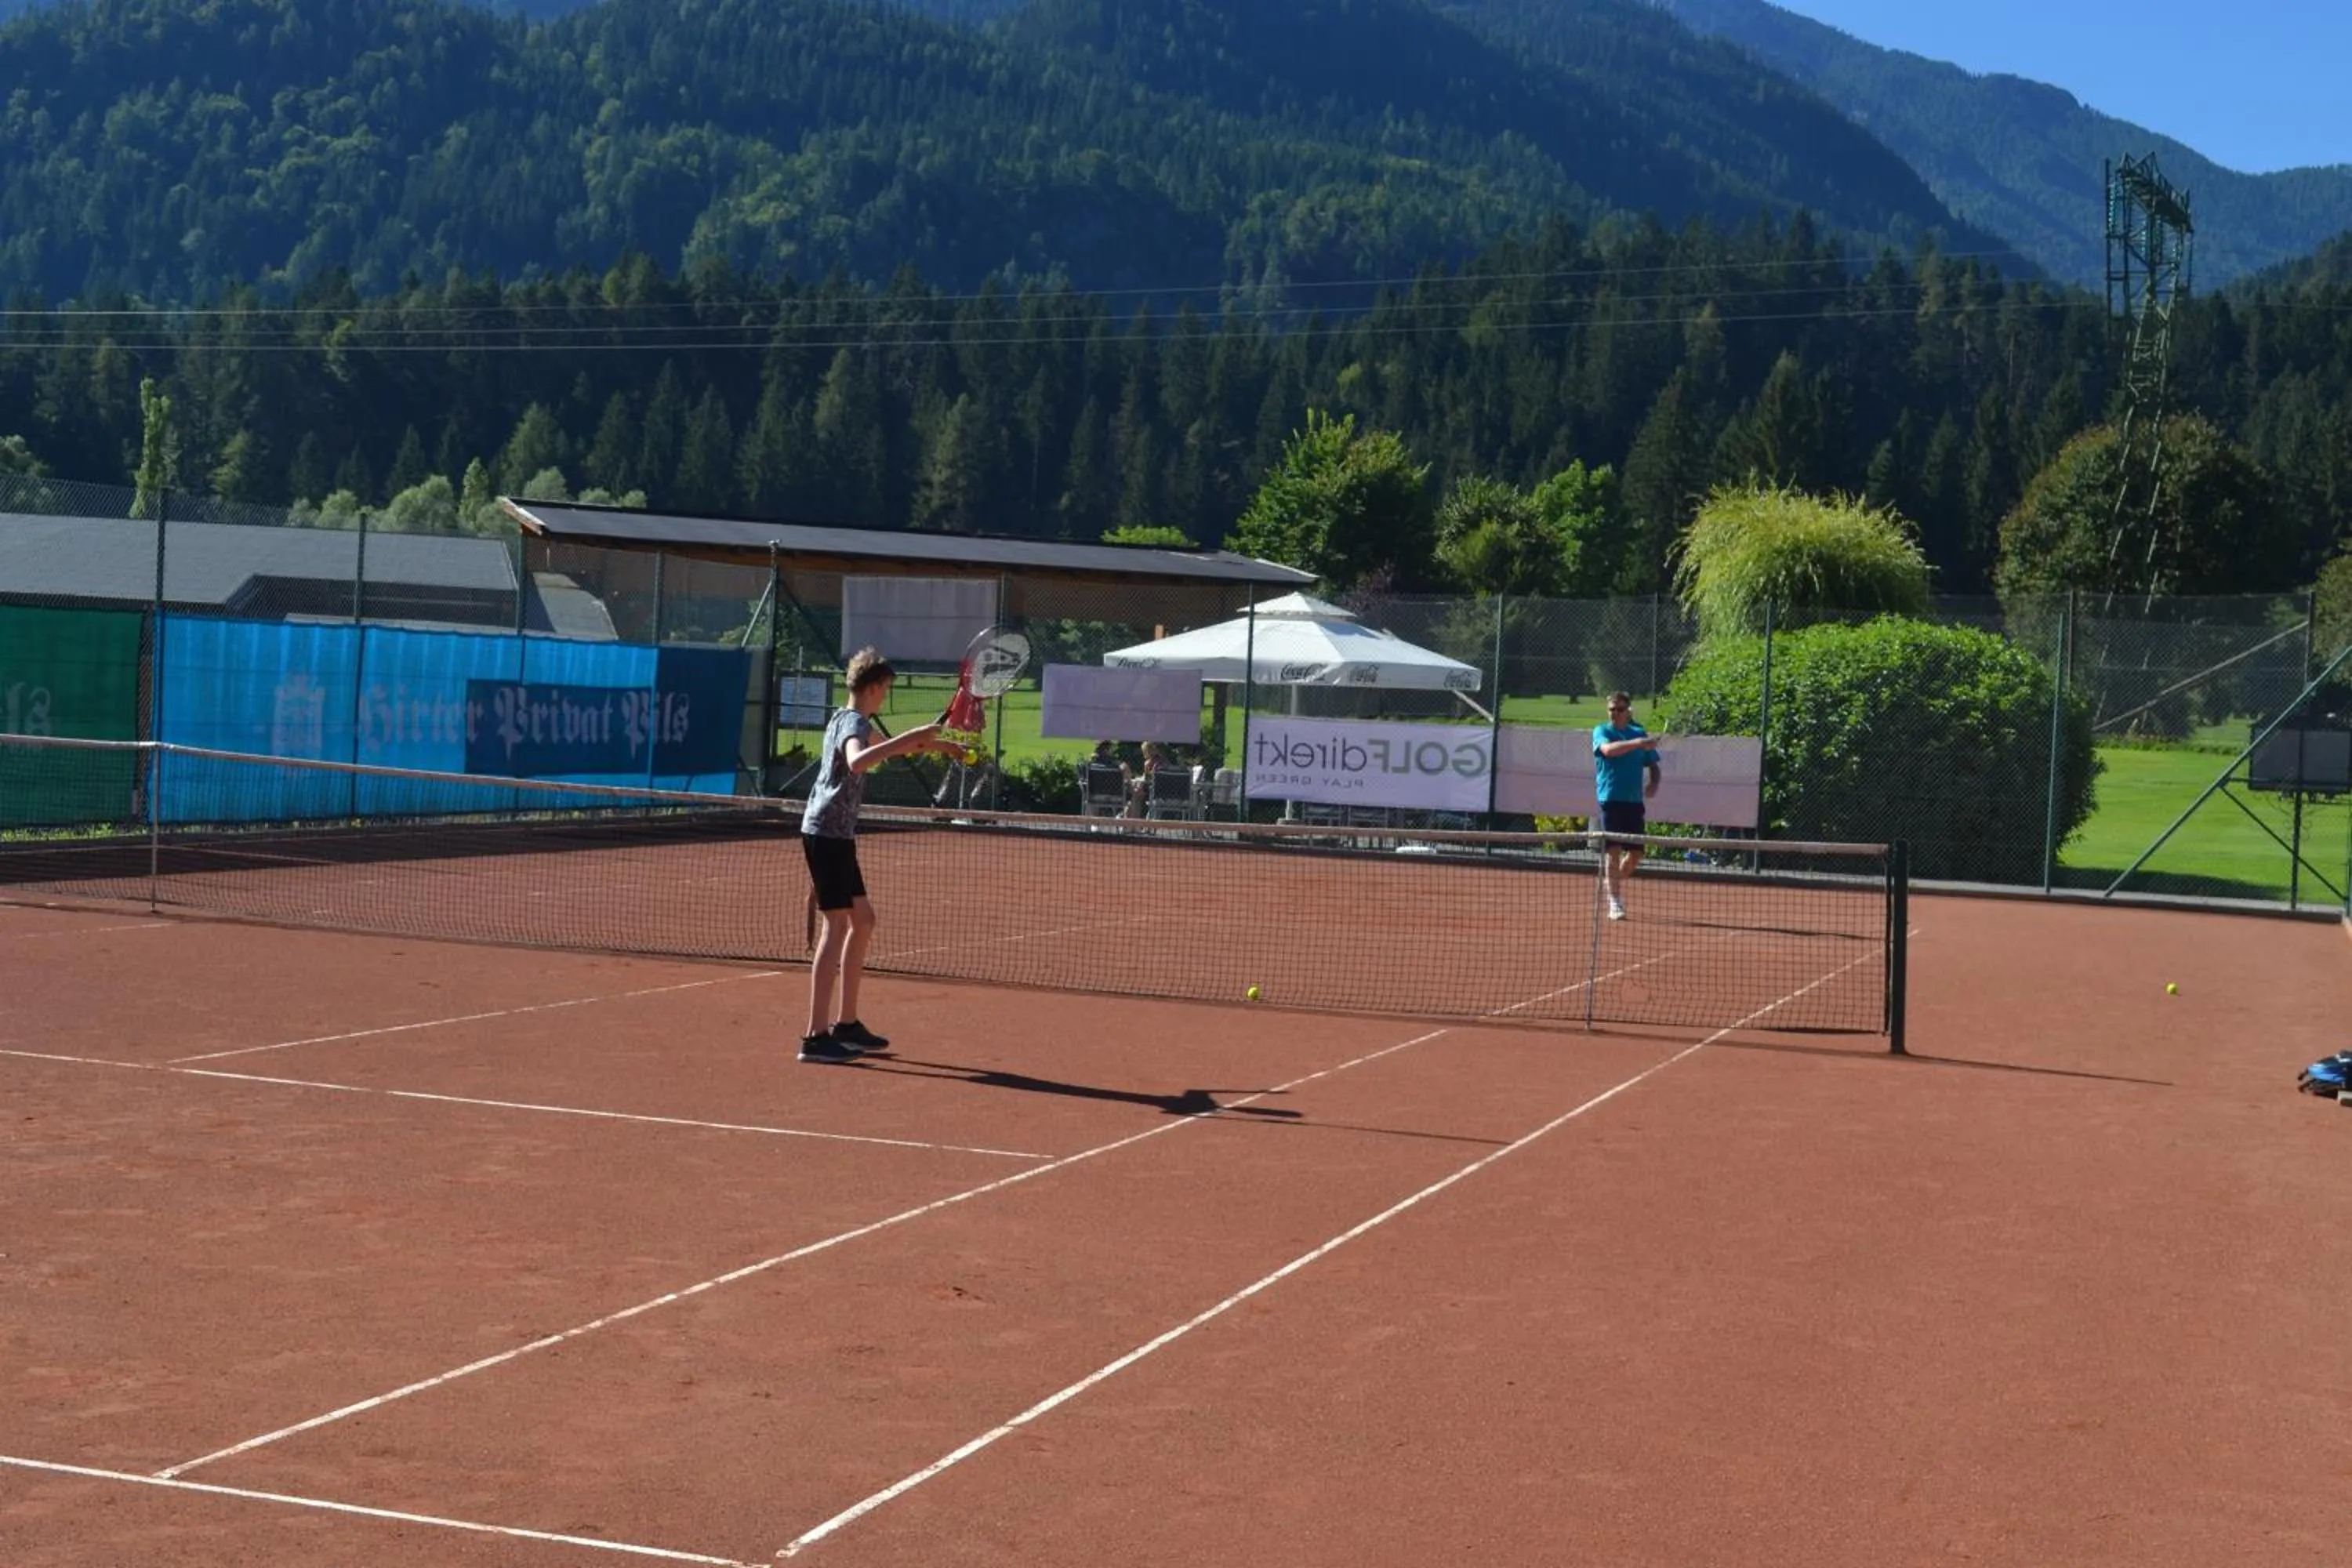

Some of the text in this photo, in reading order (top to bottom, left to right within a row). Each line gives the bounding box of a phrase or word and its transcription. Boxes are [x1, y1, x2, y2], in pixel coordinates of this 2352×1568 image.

[0, 681, 52, 749] ls
[494, 687, 613, 763] Privat
[621, 690, 691, 760] Pils
